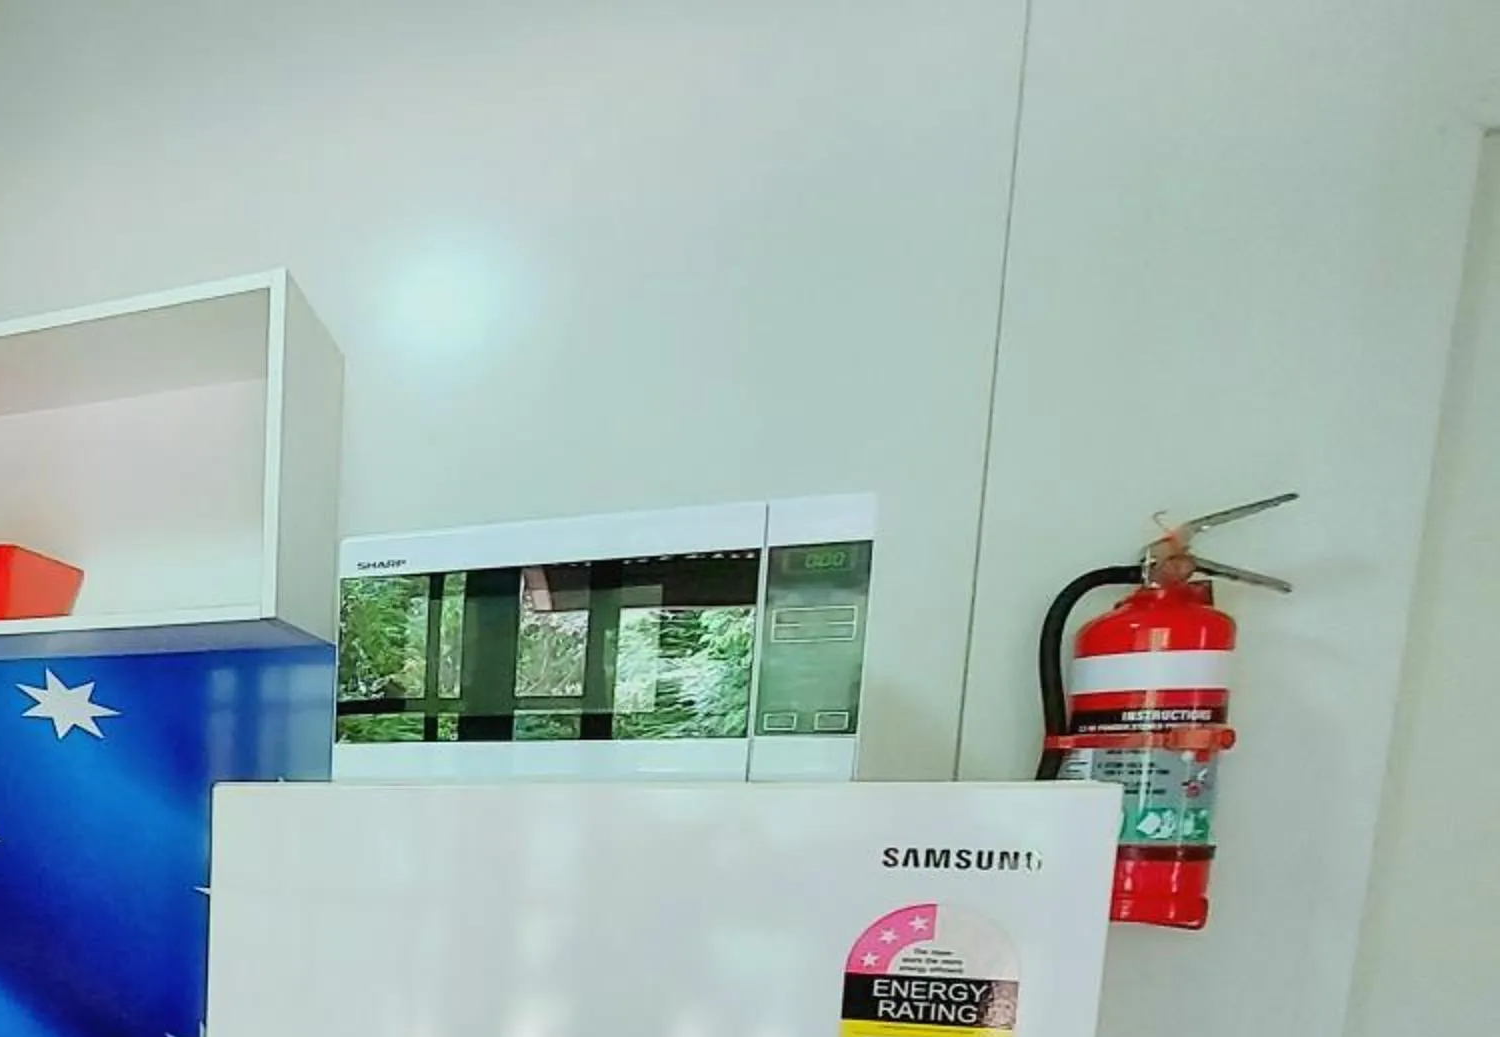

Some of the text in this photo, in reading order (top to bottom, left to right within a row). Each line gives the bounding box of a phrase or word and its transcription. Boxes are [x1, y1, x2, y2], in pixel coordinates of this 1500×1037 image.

[357, 559, 407, 570] SHARP
[872, 979, 987, 1003] ENERGY
[877, 1000, 979, 1024] RATING
